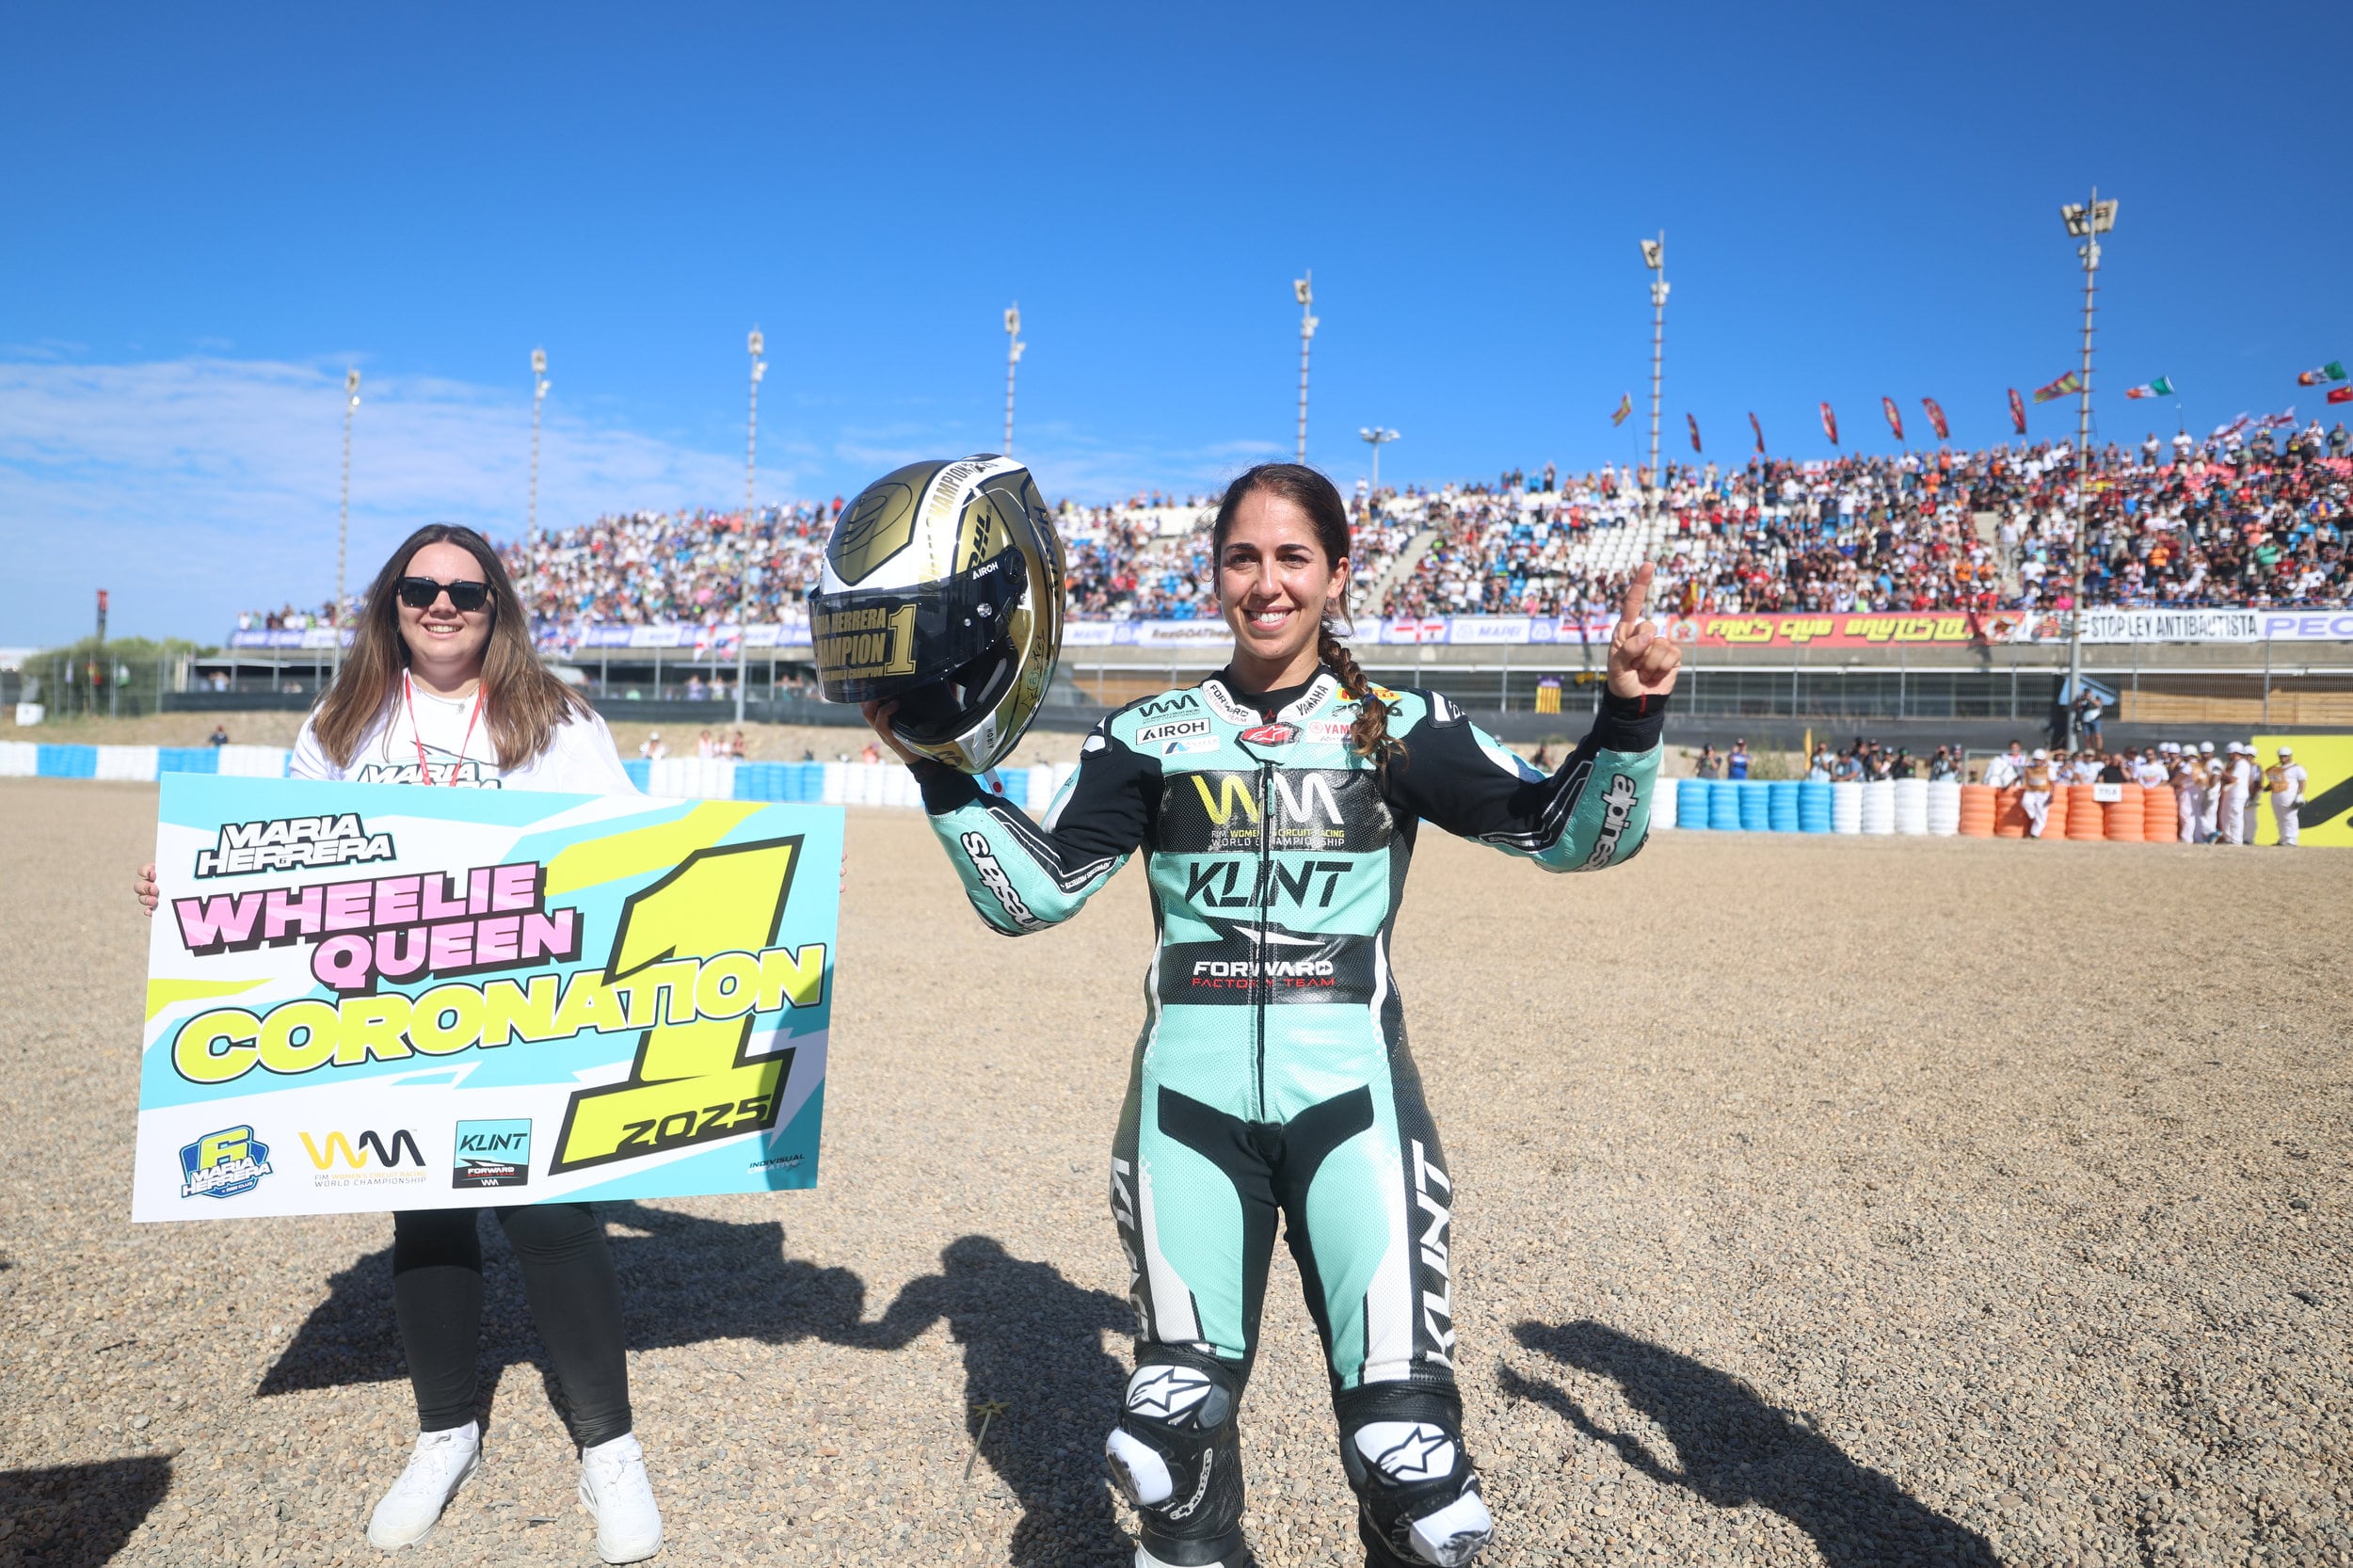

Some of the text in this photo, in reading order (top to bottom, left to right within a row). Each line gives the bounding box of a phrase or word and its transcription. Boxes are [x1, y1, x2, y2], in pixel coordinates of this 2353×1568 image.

[972, 561, 999, 581] AIROH
[831, 608, 887, 633] HERRERA
[1778, 618, 1834, 643] CLUB
[2091, 616, 2125, 637] STOP
[2128, 616, 2153, 637] LEY
[814, 632, 887, 668] HAMPION
[885, 603, 917, 676] 1
[1295, 684, 1329, 716] YAMAHA
[986, 727, 995, 749] AIROH
[1142, 721, 1205, 742] AIROH
[1324, 723, 1350, 735] YAM
[219, 813, 364, 849] MARIA
[1211, 837, 1345, 847] WORLD CHAMPIOSHIP
[1319, 829, 1345, 838] ACING
[196, 834, 393, 877] HERRERA
[959, 830, 1052, 932] nestars
[1184, 858, 1354, 909] KLINT
[173, 862, 544, 954] WHEELIE
[310, 906, 584, 996] QUEEN
[1193, 960, 1335, 977] FORWARD
[1191, 977, 1336, 989] FACTORY TEAM
[172, 943, 825, 1084] CORONATION
[615, 1094, 772, 1152] 2025
[458, 1132, 528, 1152] KLINT
[190, 1156, 255, 1182] MARIA
[467, 1166, 515, 1175] FORWARD
[749, 1153, 806, 1169] INDIVISUAL
[182, 1163, 271, 1197] HERRERA
[314, 1176, 427, 1188] WORLD CHAMPIONSHIP
[1411, 1138, 1454, 1369] KLINT
